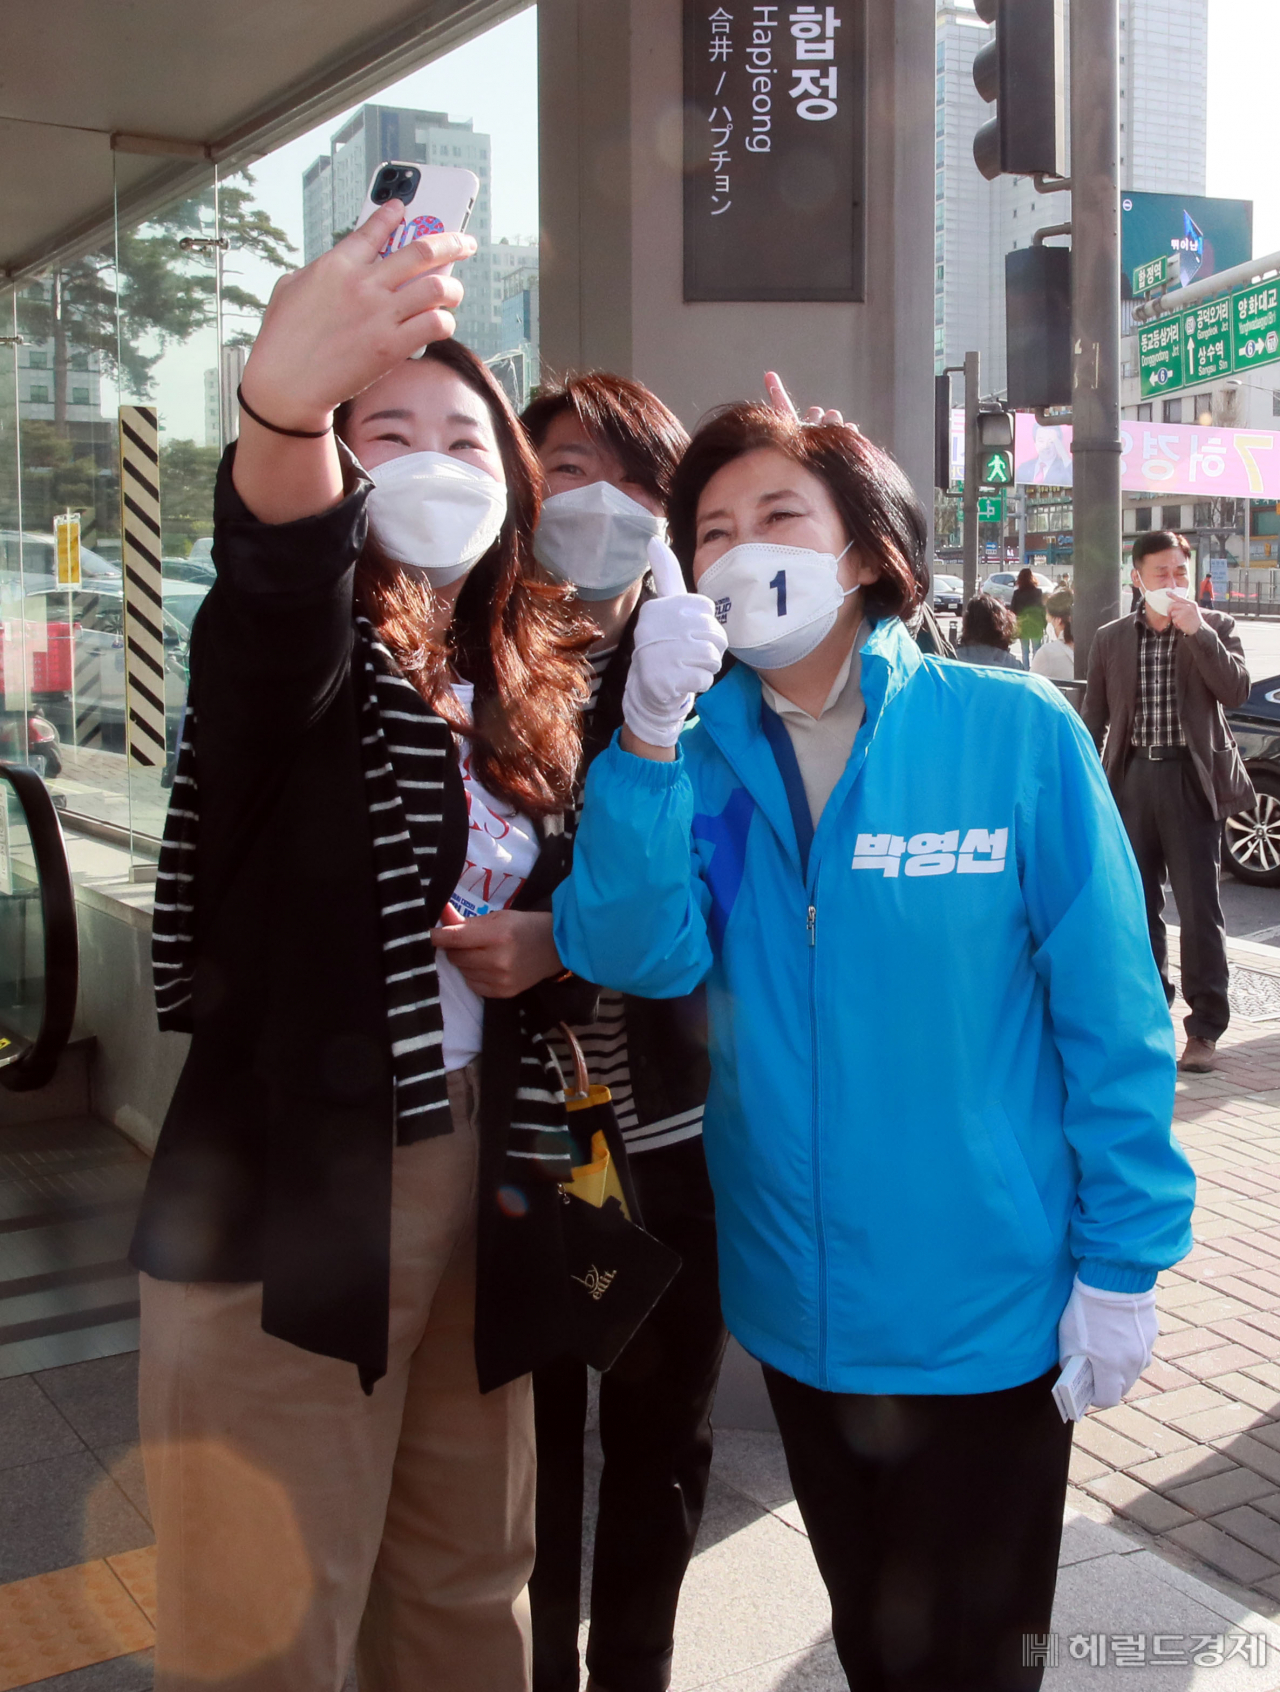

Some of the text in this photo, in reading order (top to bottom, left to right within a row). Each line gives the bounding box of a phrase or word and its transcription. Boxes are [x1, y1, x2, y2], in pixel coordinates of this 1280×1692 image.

[708, 6, 734, 62] 合井
[788, 6, 841, 121] 합정
[745, 6, 778, 152] Hapjeong
[708, 106, 733, 215] ハプチョン
[1171, 239, 1198, 251] 뛰어난
[1138, 260, 1162, 289] 합정역
[1196, 300, 1229, 329] 공덕오거리
[1237, 288, 1278, 320] 양화대교
[1140, 322, 1179, 352] 동교동삼거리
[1248, 344, 1253, 355] 6
[1198, 340, 1224, 365] 상수역
[1160, 371, 1166, 381] 6
[1198, 364, 1217, 376] Sangsu
[769, 569, 787, 617] 1
[851, 827, 1009, 878] 박영선
